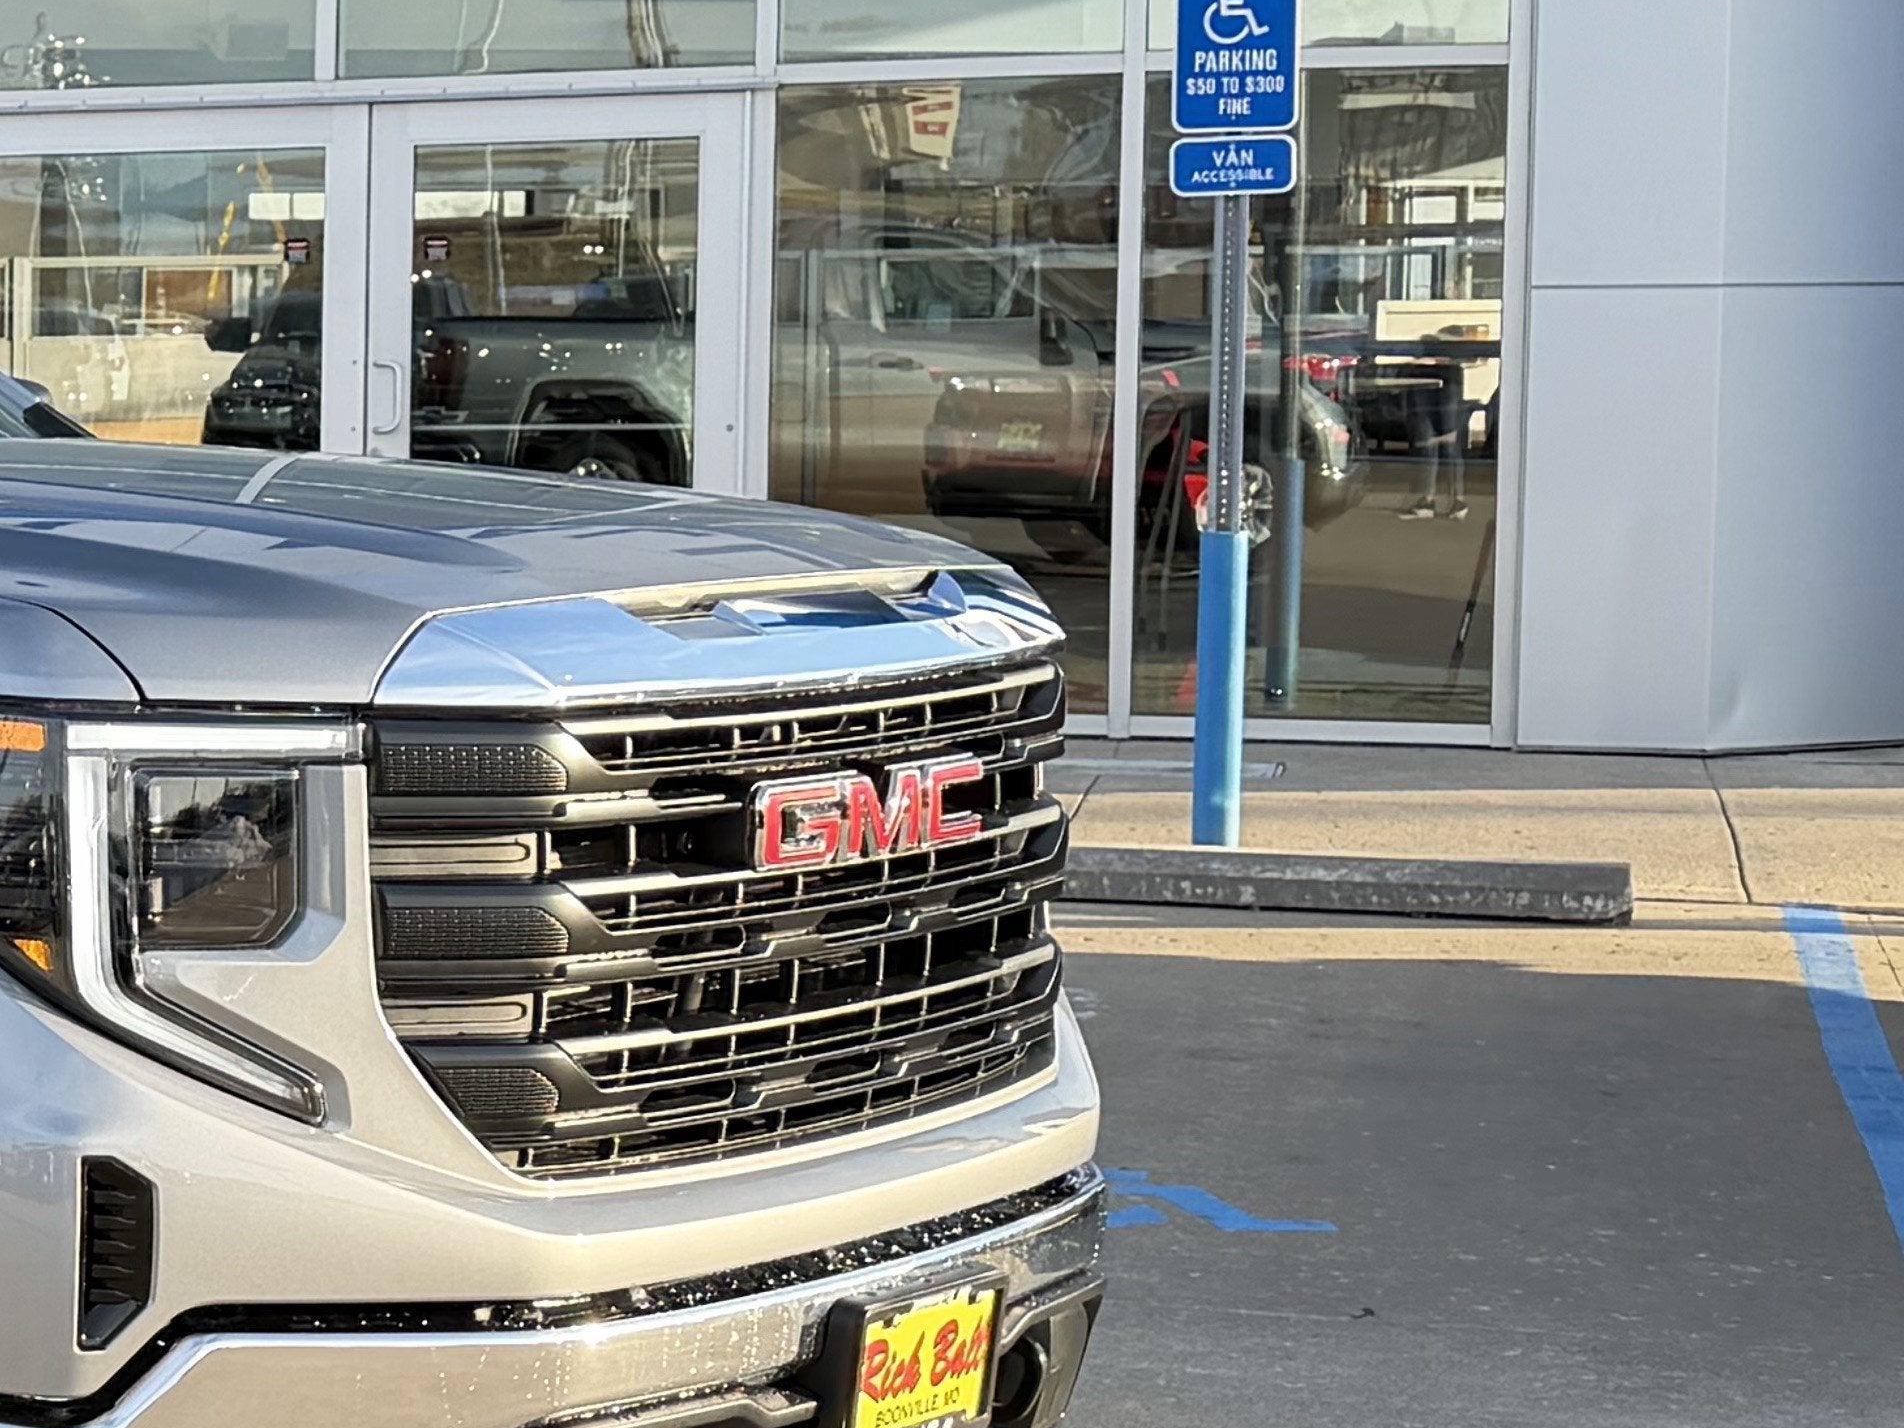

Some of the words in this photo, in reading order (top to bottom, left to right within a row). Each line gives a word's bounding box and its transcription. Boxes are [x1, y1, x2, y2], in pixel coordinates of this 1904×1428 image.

[1194, 50, 1277, 72] PARKING
[1186, 78, 1216, 94] $50
[1222, 77, 1240, 93] TO
[1245, 75, 1285, 93] $300
[1218, 98, 1252, 116] FINE
[1213, 149, 1253, 166] VAN
[1192, 168, 1274, 183] ACCESSIBLE
[750, 753, 984, 871] GMC
[861, 1330, 922, 1403] Rick
